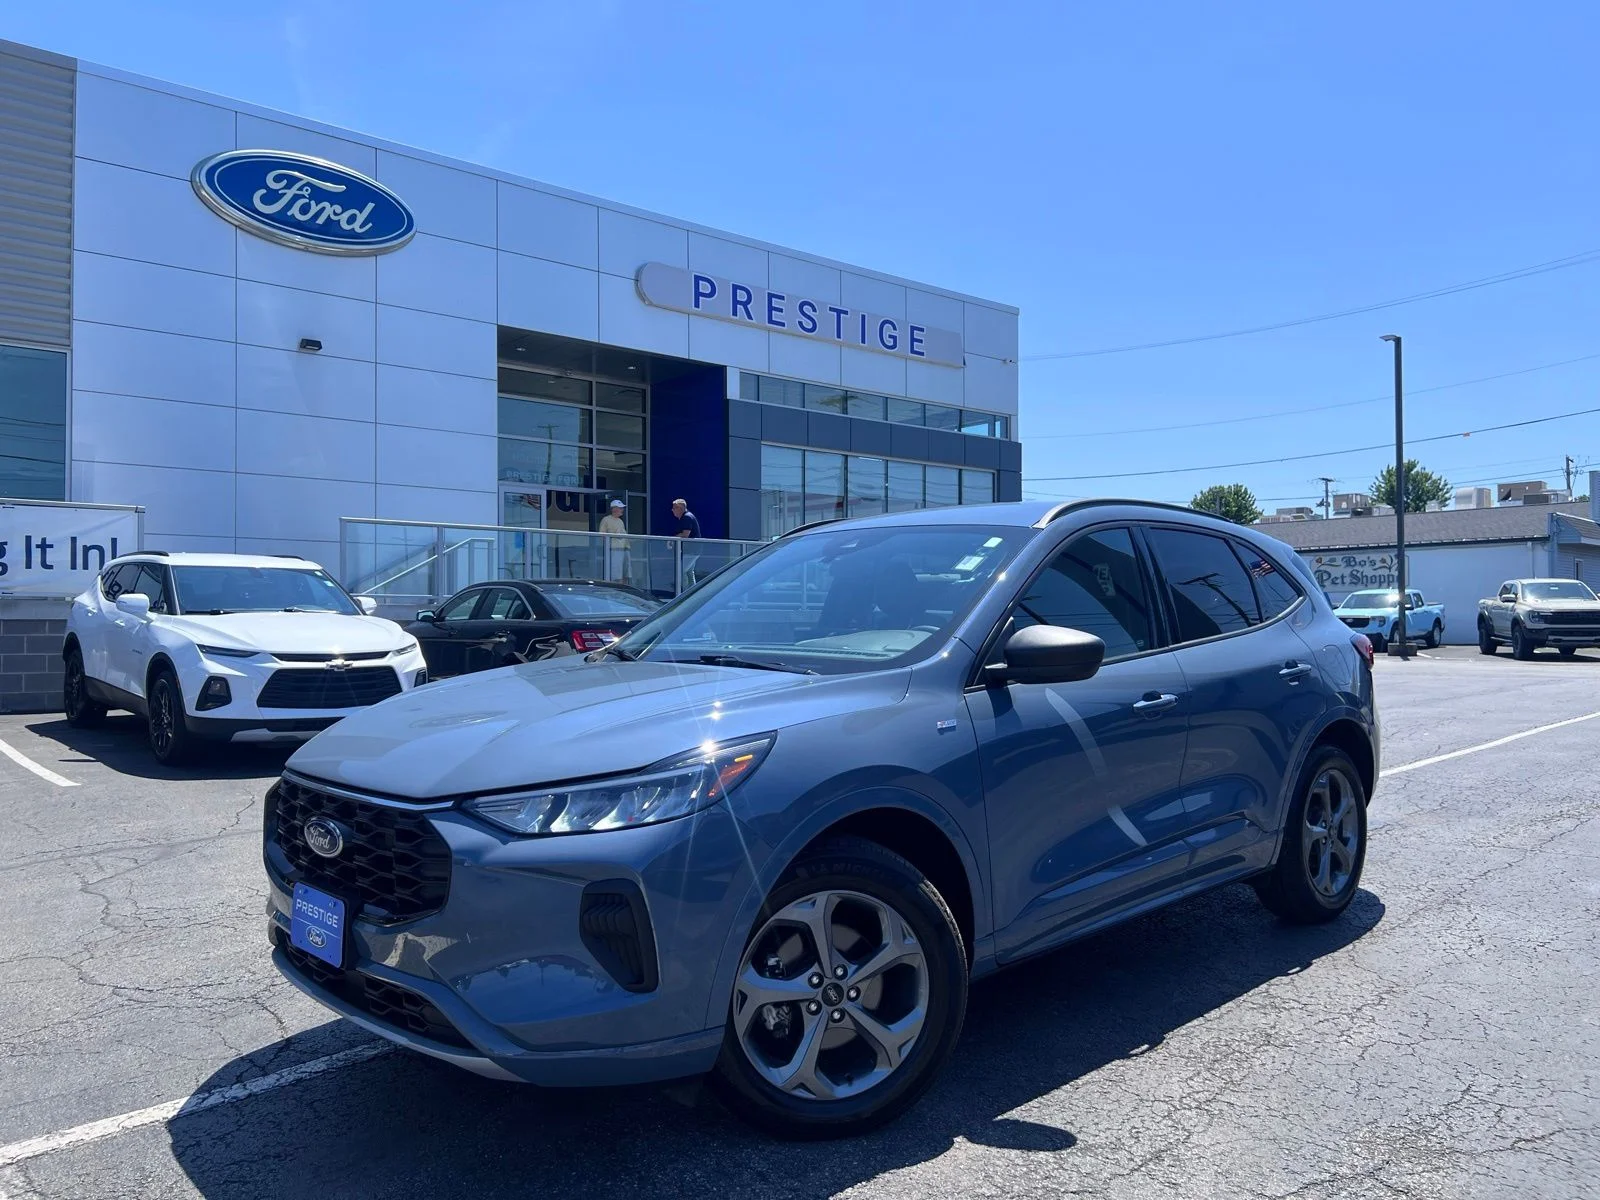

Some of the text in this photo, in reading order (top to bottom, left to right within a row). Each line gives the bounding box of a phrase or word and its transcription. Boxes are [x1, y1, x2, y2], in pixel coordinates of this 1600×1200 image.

[252, 169, 376, 234] Ford
[692, 274, 926, 357] PRESTIGE
[24, 535, 54, 570] It
[1341, 556, 1377, 569] Bo's
[1314, 569, 1400, 588] Pet Shopp
[309, 825, 330, 850] Ford
[295, 898, 339, 928] PRESTIGE
